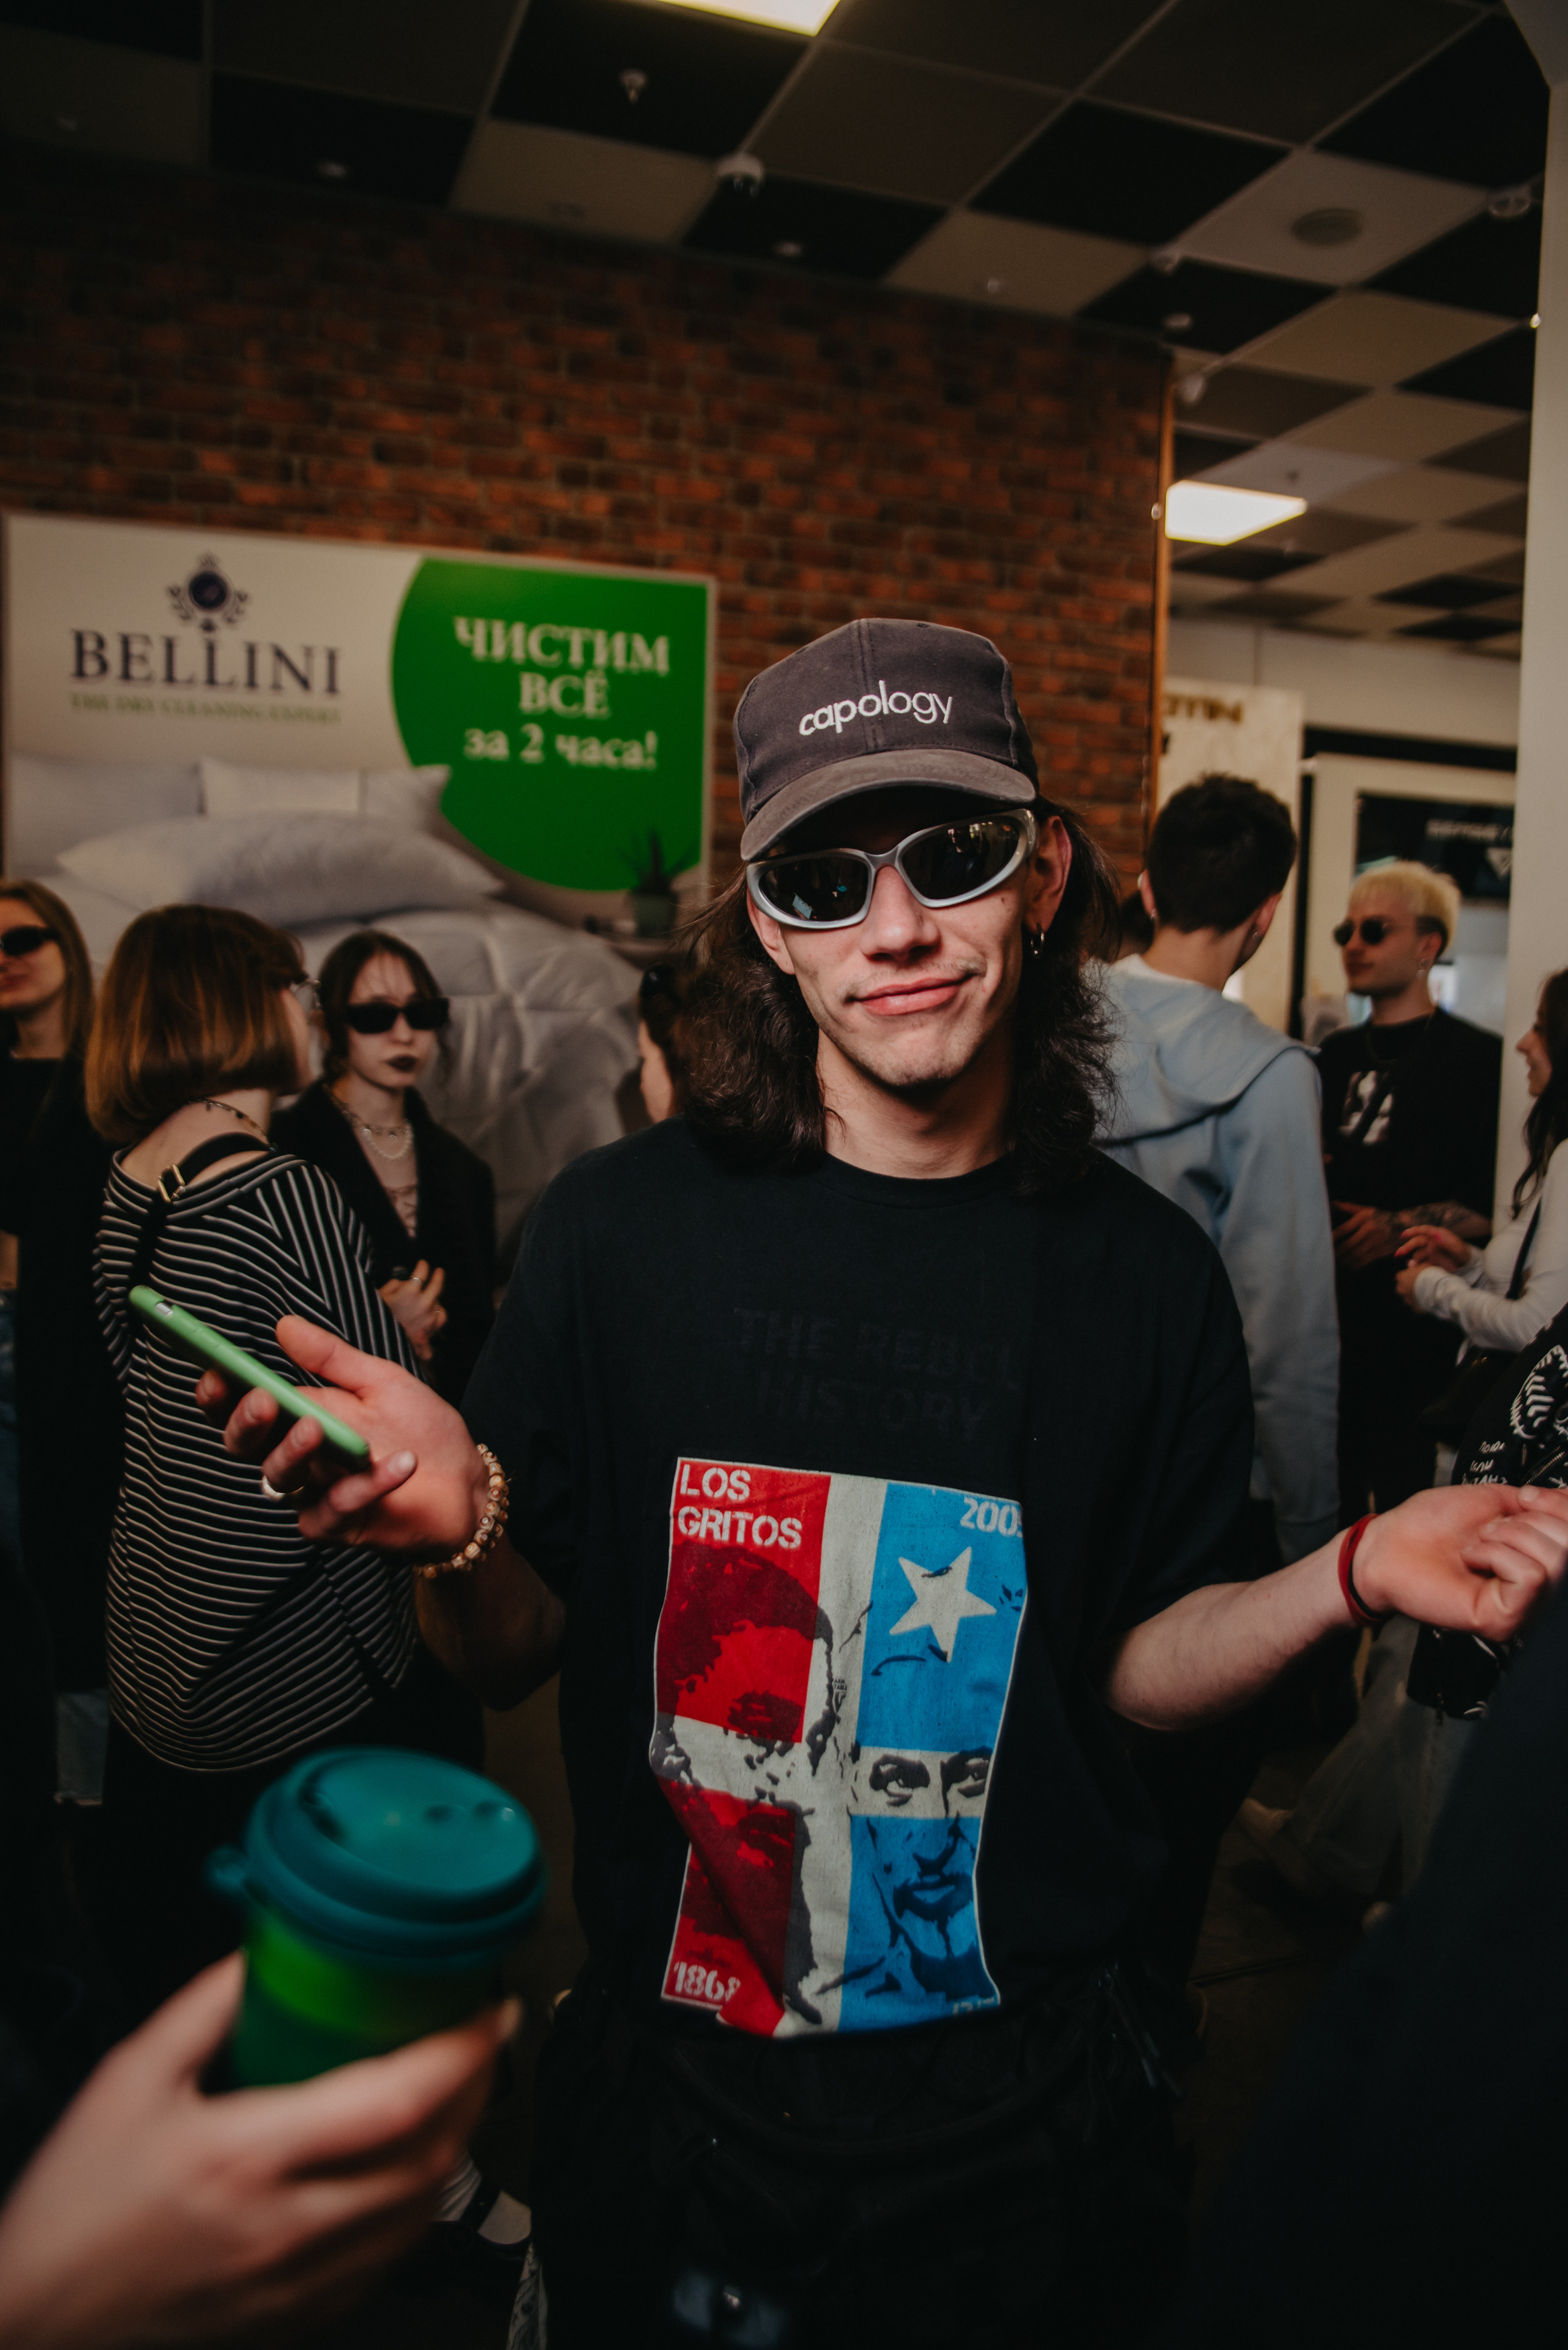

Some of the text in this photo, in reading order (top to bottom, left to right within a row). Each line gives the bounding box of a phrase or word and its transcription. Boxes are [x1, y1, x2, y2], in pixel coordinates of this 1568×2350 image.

[70, 628, 342, 696] BELLINI
[452, 616, 670, 678] ЧИСТИМ
[518, 671, 610, 720] ВСЁ
[799, 679, 953, 736] capology
[463, 724, 658, 770] за 2 часа!
[733, 1307, 839, 1361] THE
[755, 1370, 990, 1442] HISTORY
[680, 1463, 751, 1502] LOS
[677, 1505, 803, 1550] GRITOS
[960, 1497, 1024, 1538] 200
